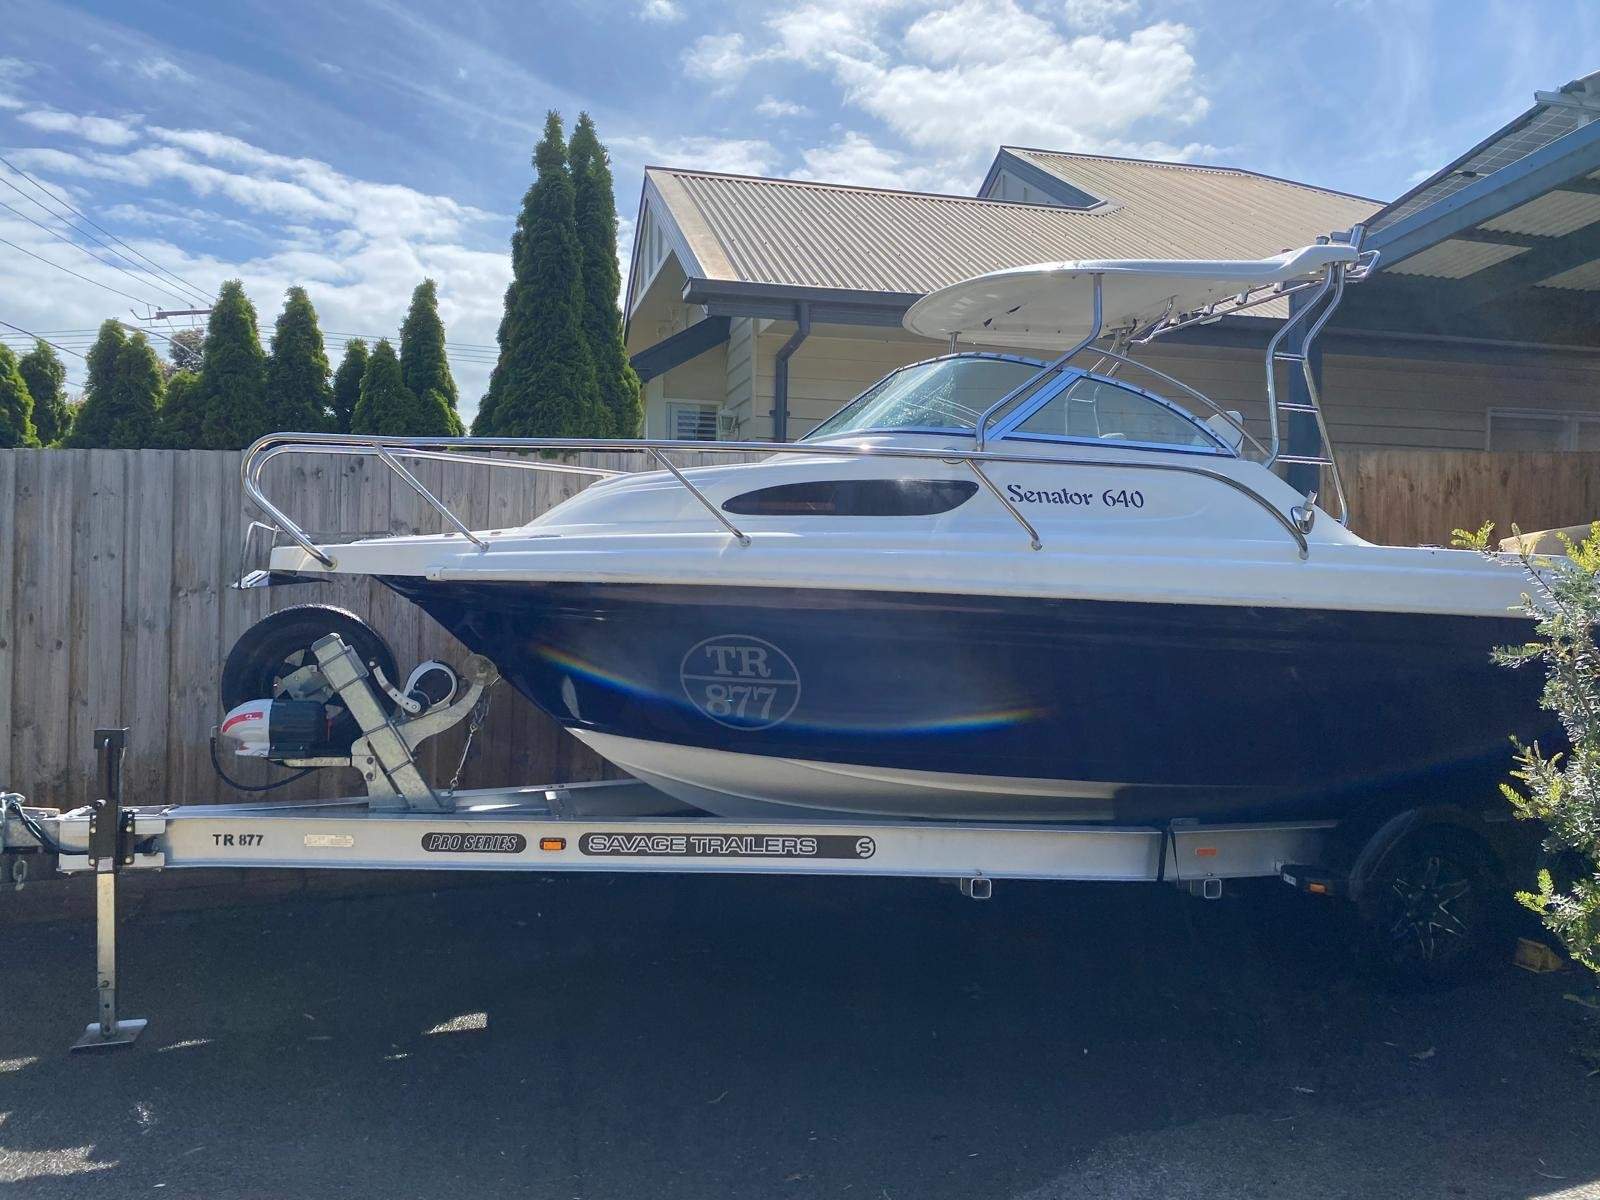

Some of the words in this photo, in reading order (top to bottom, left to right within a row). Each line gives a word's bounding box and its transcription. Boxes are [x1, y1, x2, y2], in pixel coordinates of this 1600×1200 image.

[1007, 484, 1093, 506] Senator
[1102, 489, 1144, 508] 640
[705, 645, 771, 678] TR
[705, 684, 777, 719] 877
[212, 834, 234, 846] TR
[238, 834, 264, 847] 877
[429, 834, 462, 850] PRO
[464, 835, 518, 851] SERIES
[588, 835, 687, 853] SAVAGE
[690, 836, 818, 855] TRAILERS
